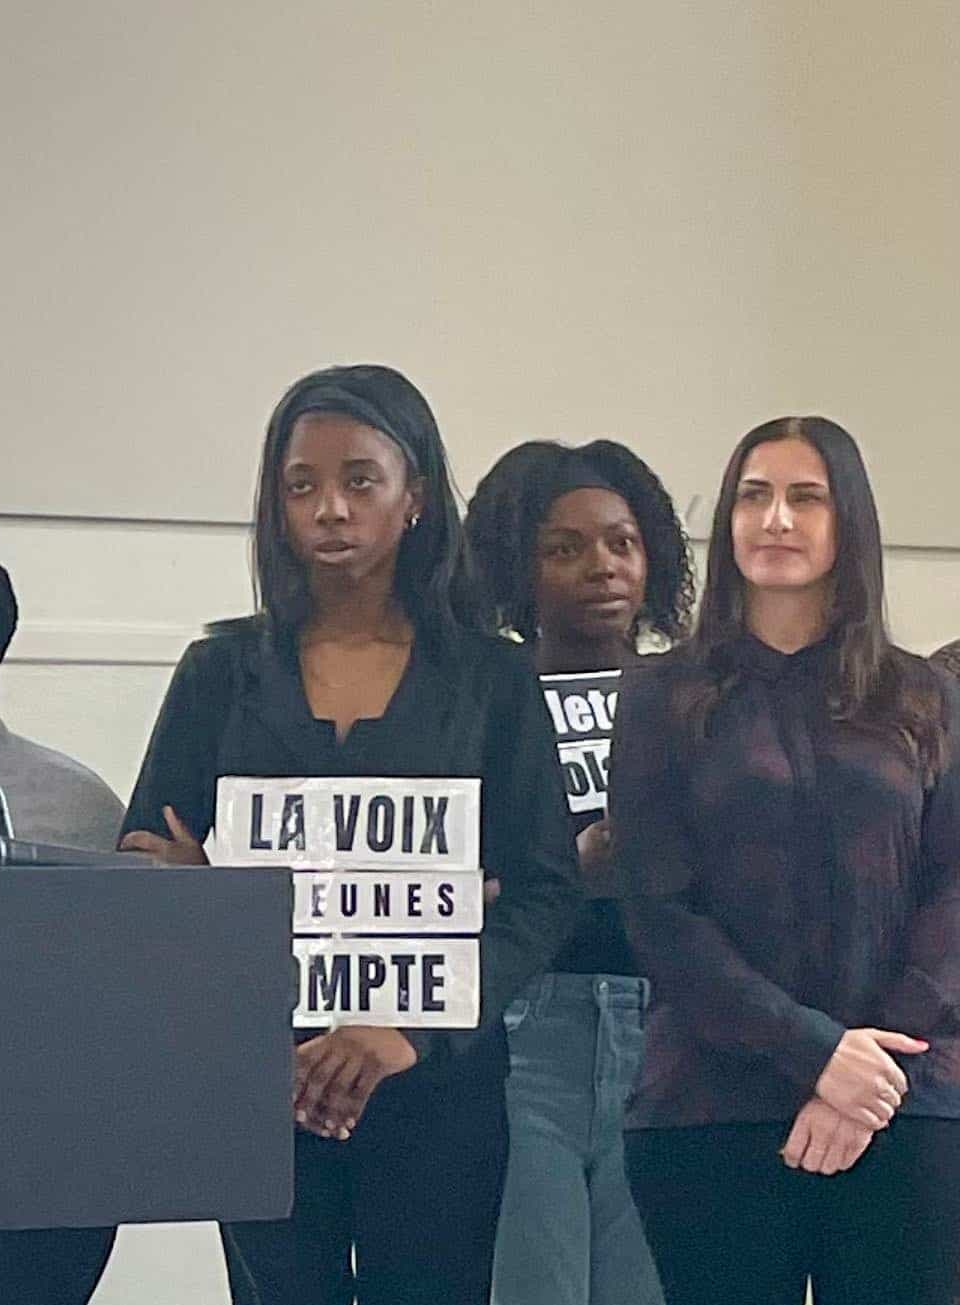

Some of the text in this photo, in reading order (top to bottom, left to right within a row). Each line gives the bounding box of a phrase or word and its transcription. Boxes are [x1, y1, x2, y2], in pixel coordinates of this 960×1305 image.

[562, 752, 610, 796] ol
[249, 793, 449, 854] LA VOIX
[311, 884, 454, 917] EUNES
[293, 954, 445, 1012] MPTE
